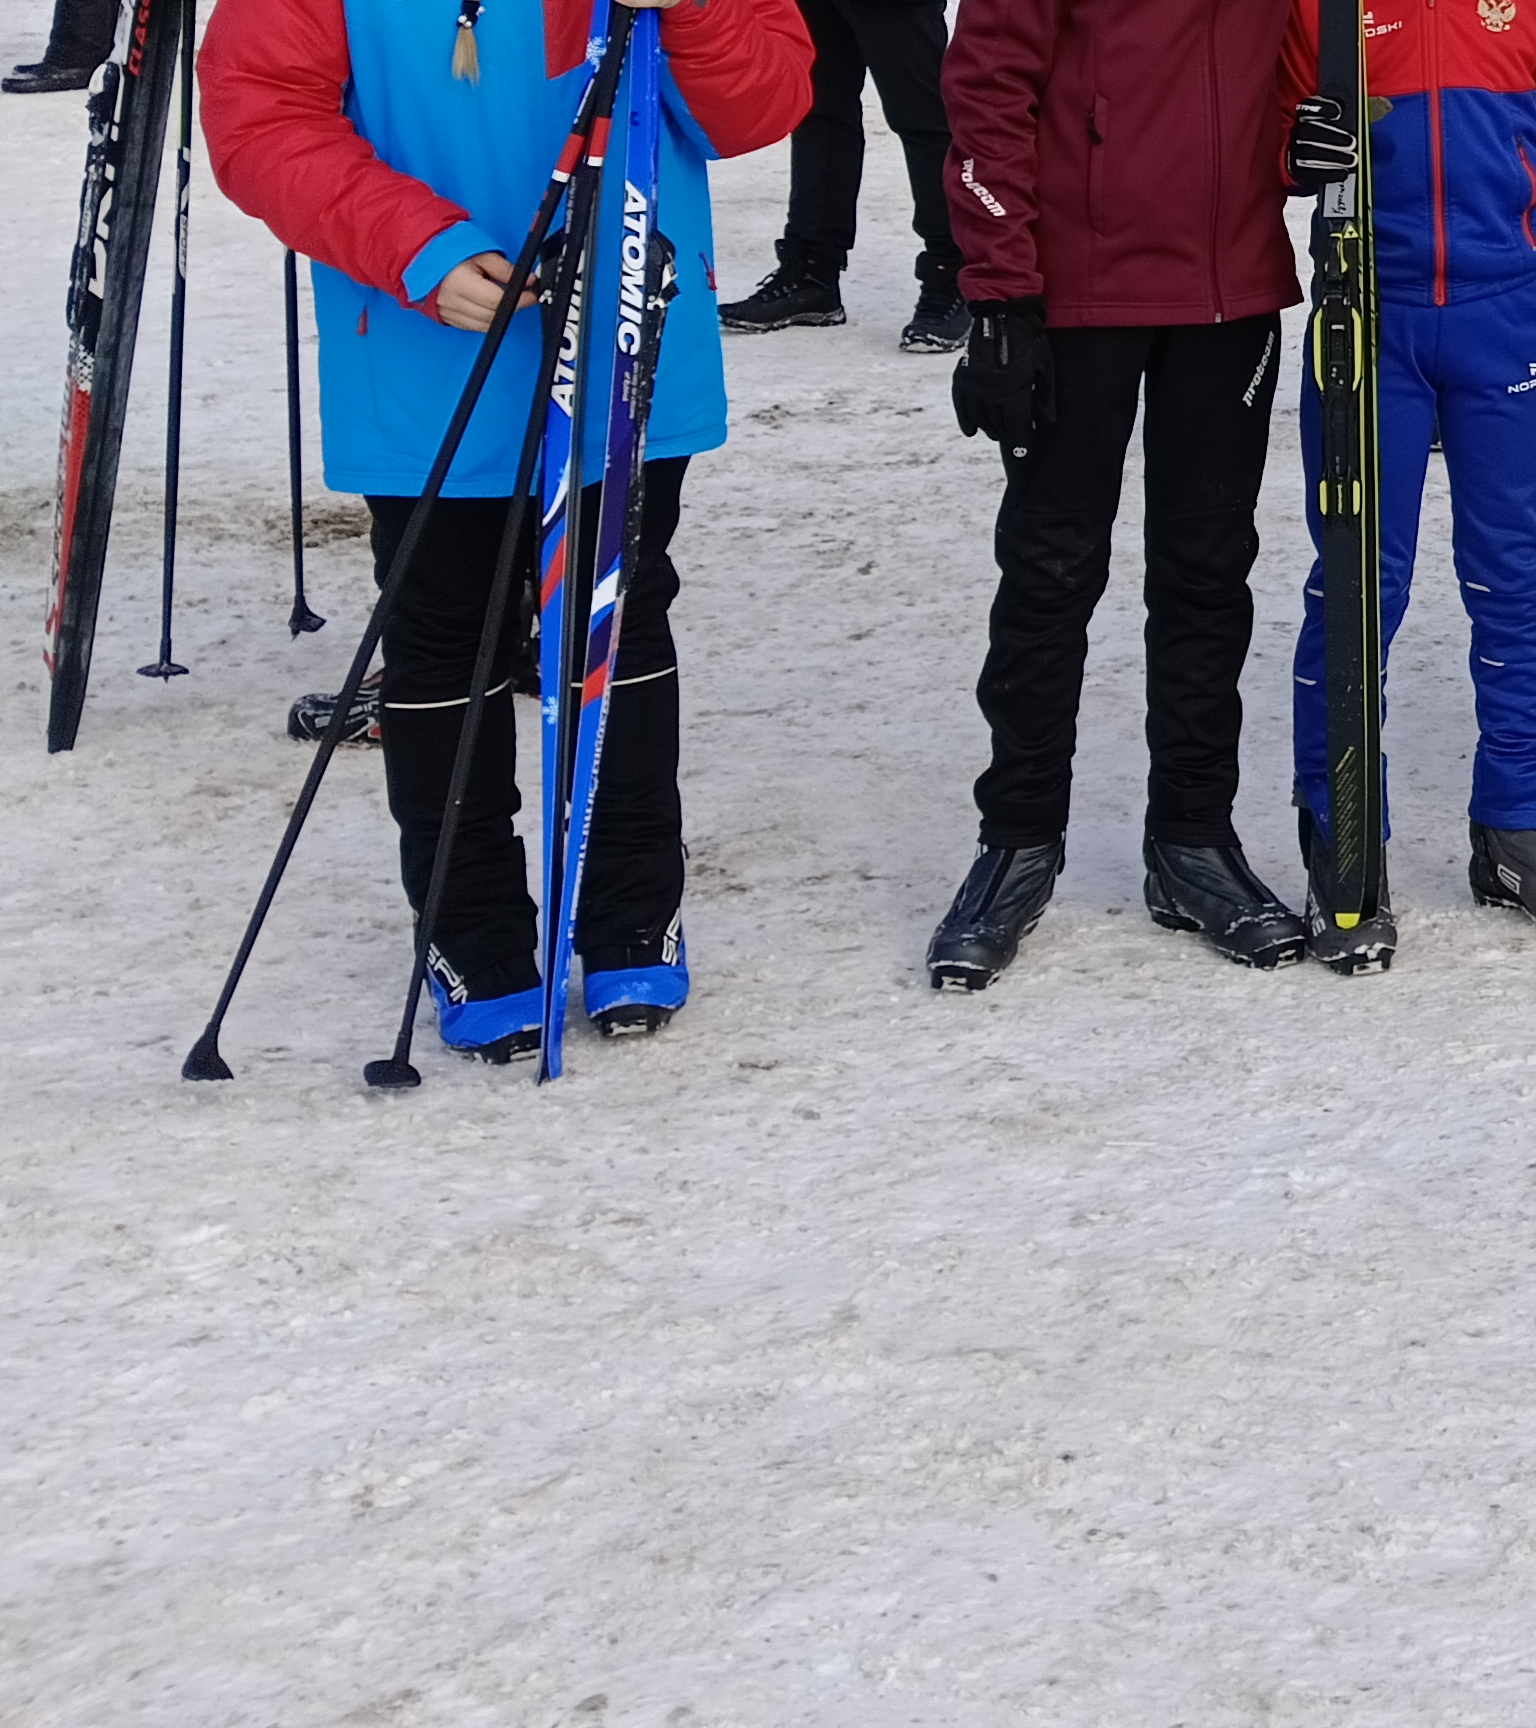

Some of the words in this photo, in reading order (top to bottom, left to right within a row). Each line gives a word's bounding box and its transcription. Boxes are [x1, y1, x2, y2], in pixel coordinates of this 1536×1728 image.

[1365, 20, 1402, 38] DSKI
[617, 178, 648, 353] ATOMIC
[1242, 330, 1275, 408] proteam
